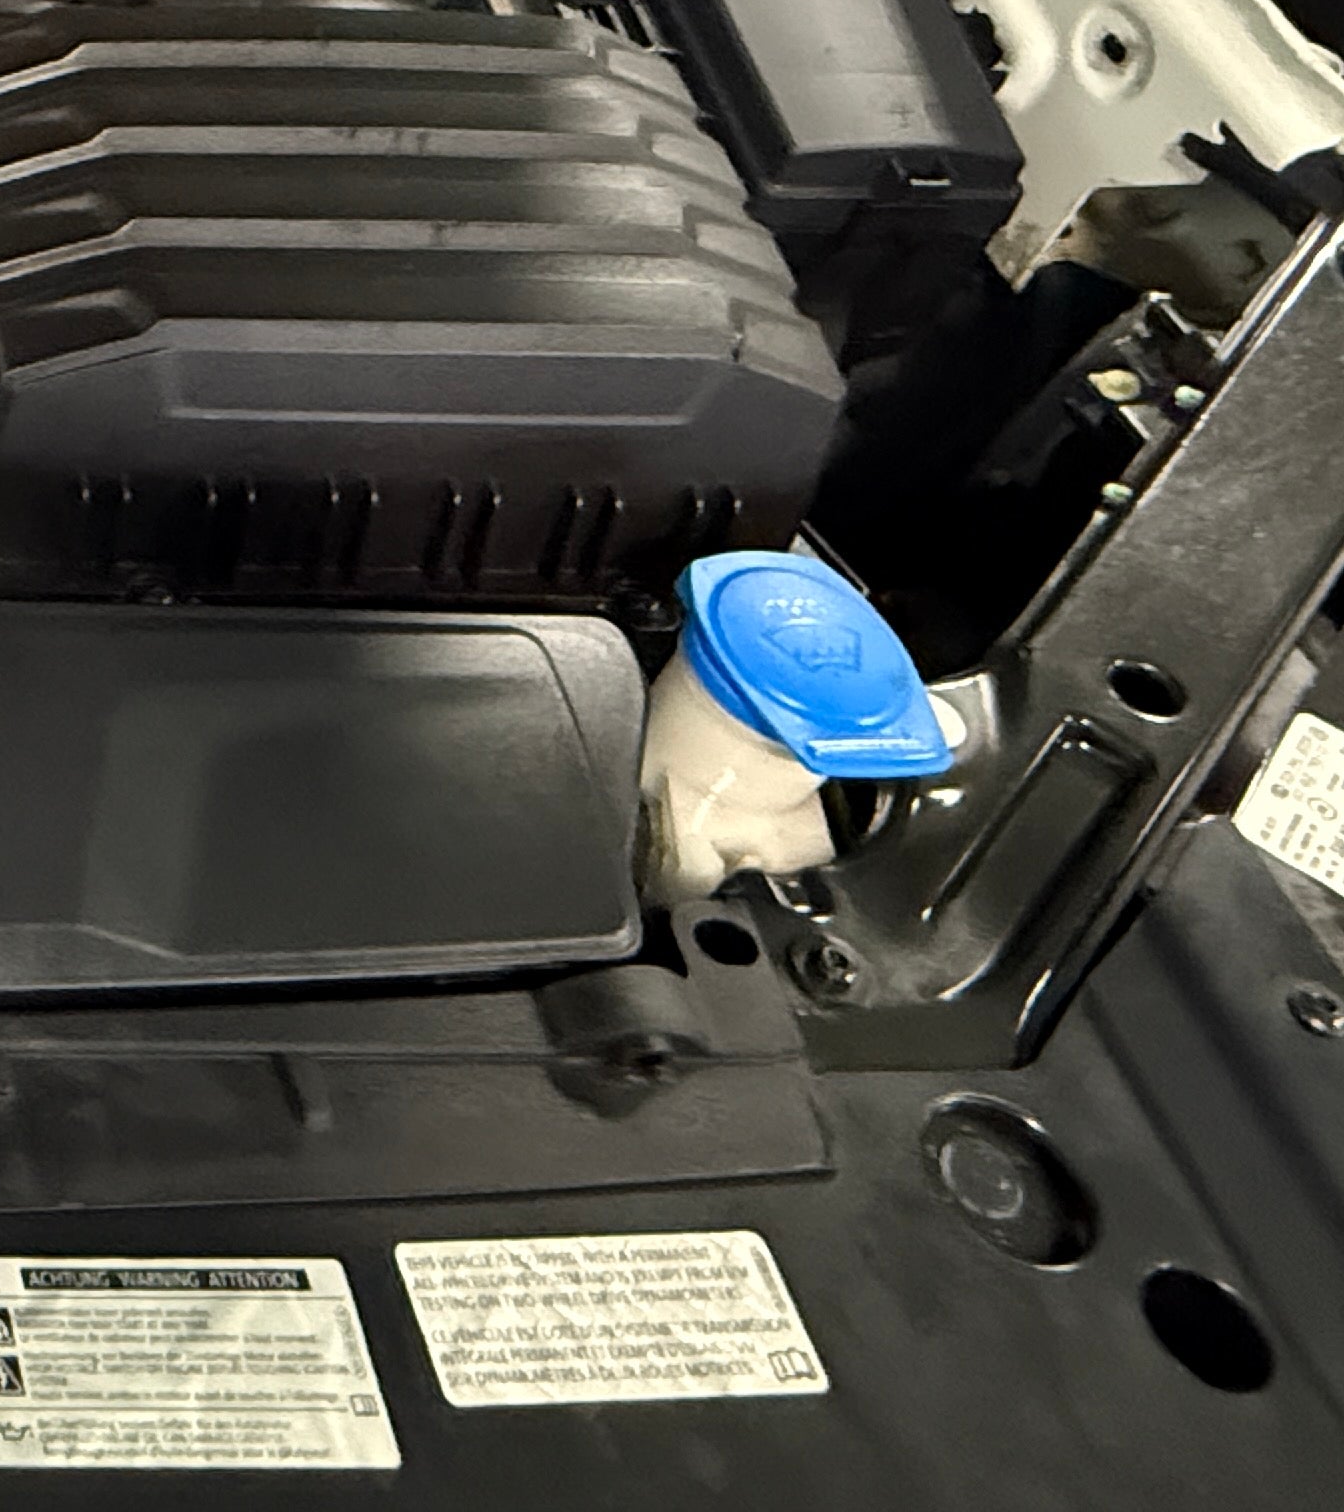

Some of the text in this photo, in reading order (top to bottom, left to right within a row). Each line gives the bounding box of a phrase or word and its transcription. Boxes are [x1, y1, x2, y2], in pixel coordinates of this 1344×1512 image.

[28, 1270, 299, 1288] ACHTUNG WARNING ATTENTION
